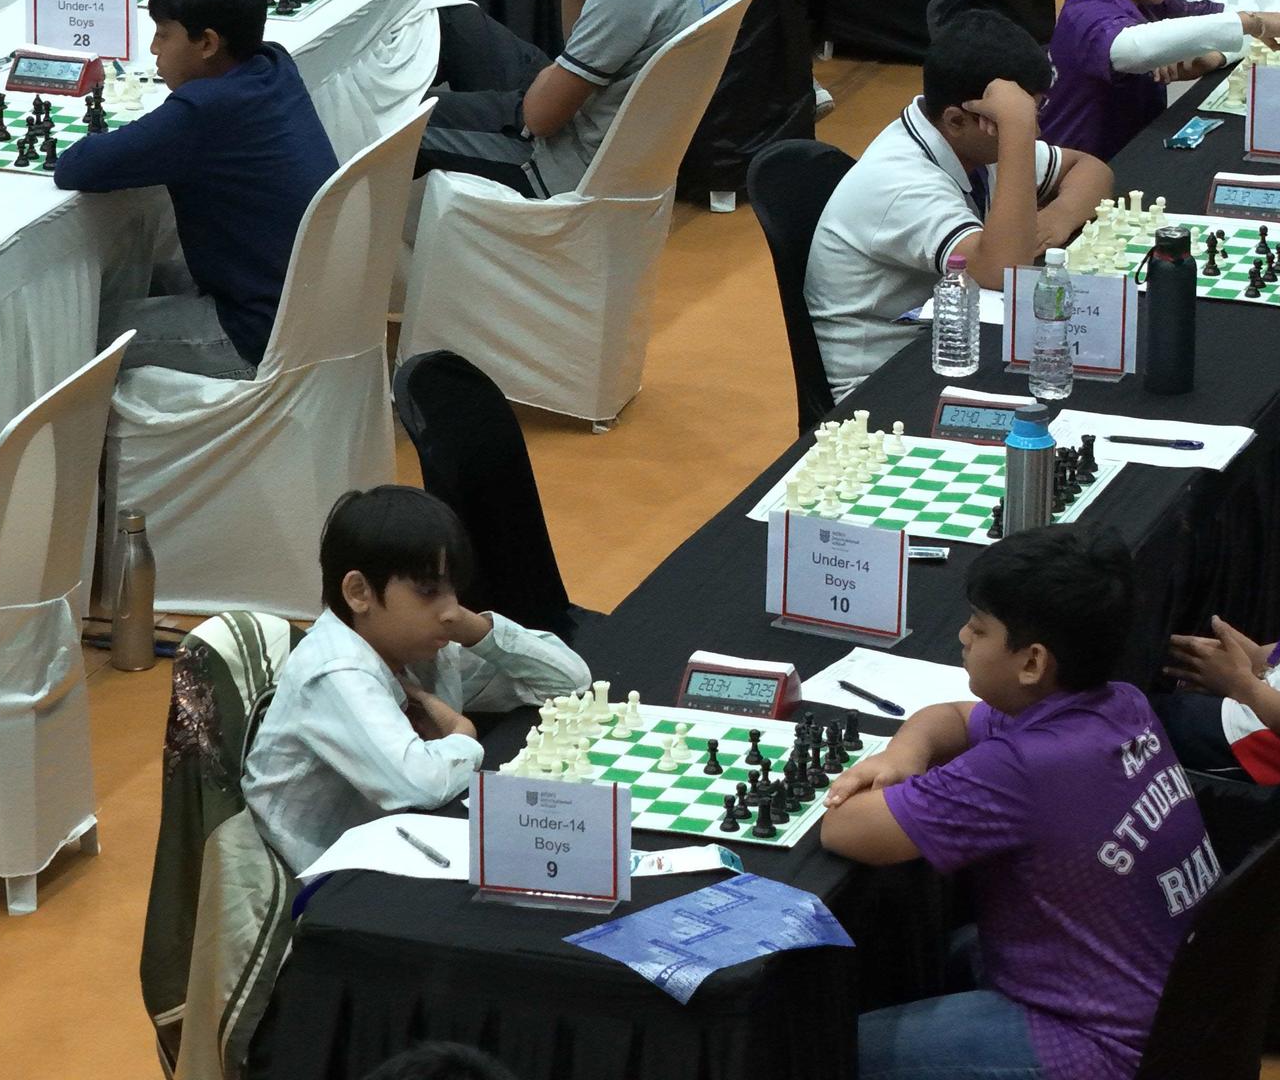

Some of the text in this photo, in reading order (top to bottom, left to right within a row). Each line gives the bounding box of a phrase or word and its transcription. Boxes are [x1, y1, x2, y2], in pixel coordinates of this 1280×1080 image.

[58, 1, 104, 13] Under-14
[69, 17, 95, 29] Boys
[73, 34, 90, 46] 28
[812, 551, 870, 573] Under-14
[825, 573, 856, 590] Boys
[830, 595, 850, 612] 10
[519, 814, 586, 832] Under-14
[535, 836, 571, 853] Boys
[546, 860, 558, 878] 9
